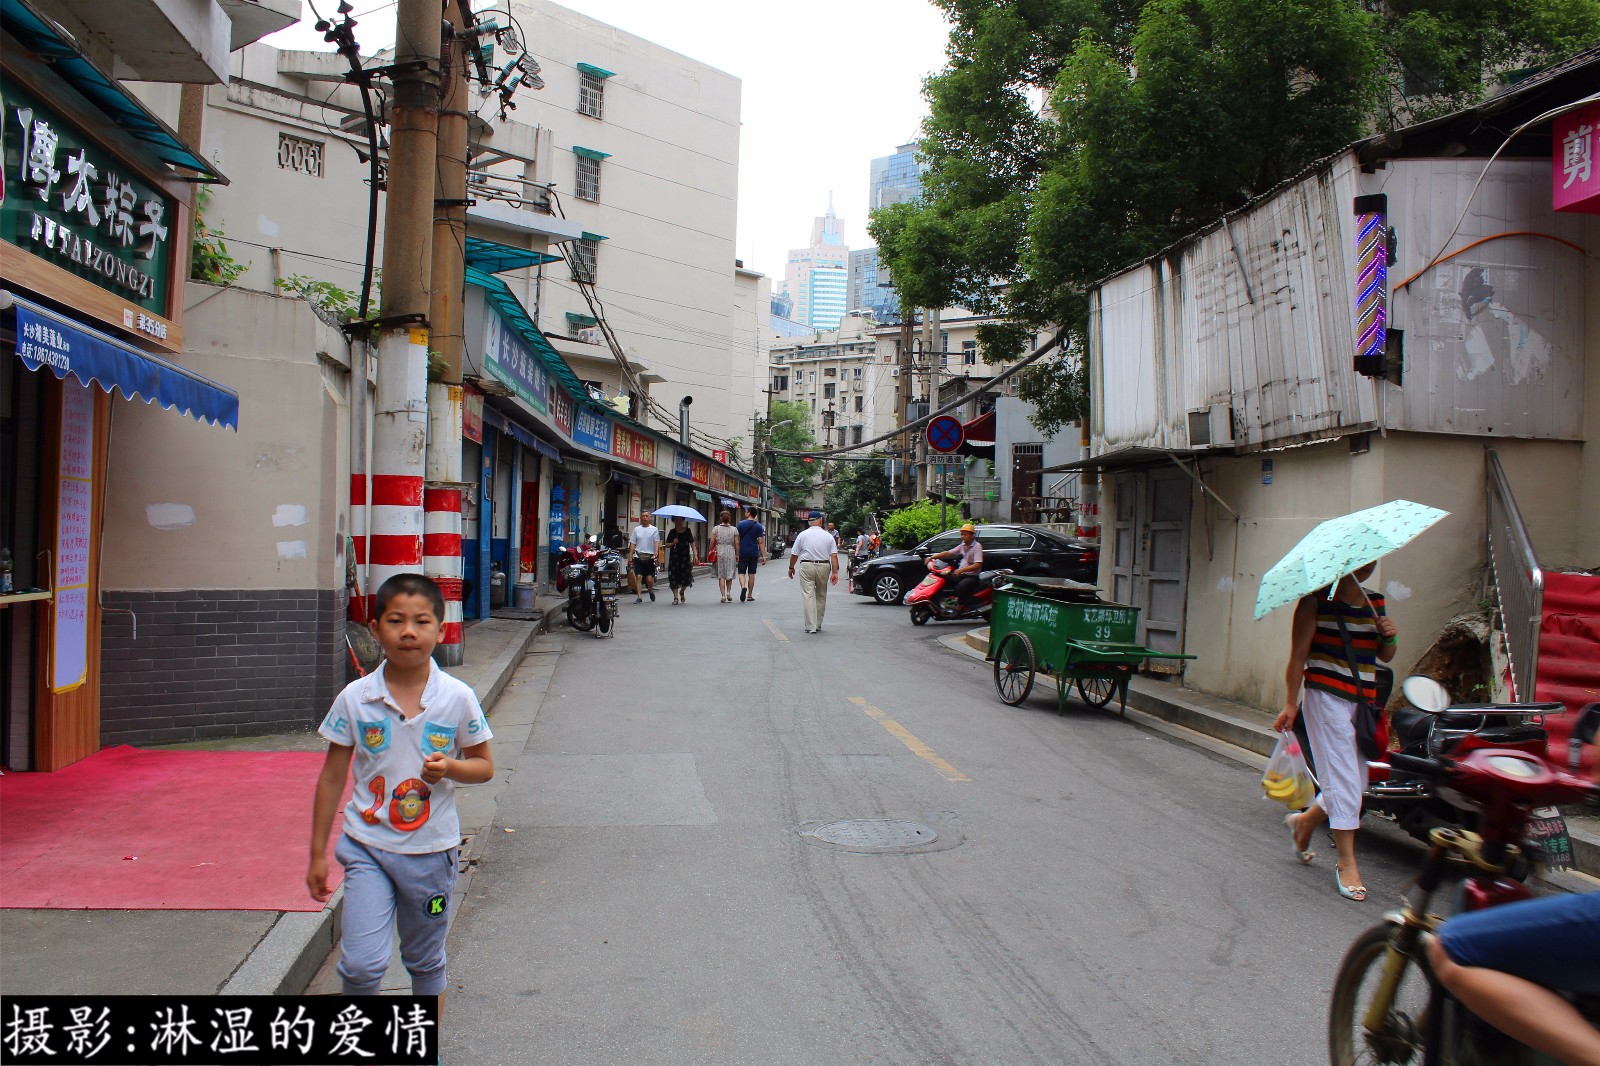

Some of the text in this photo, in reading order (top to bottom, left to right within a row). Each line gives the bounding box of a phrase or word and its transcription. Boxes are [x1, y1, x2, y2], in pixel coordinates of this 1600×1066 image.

[1563, 122, 1600, 190] 剪
[31, 212, 155, 299] FUTAIZONGZI
[928, 455, 962, 464] 消防通道
[1007, 597, 1059, 628] 爱护城市环境
[1095, 625, 1110, 638] 39
[1547, 853, 1571, 864] 1488
[431, 897, 444, 914] K
